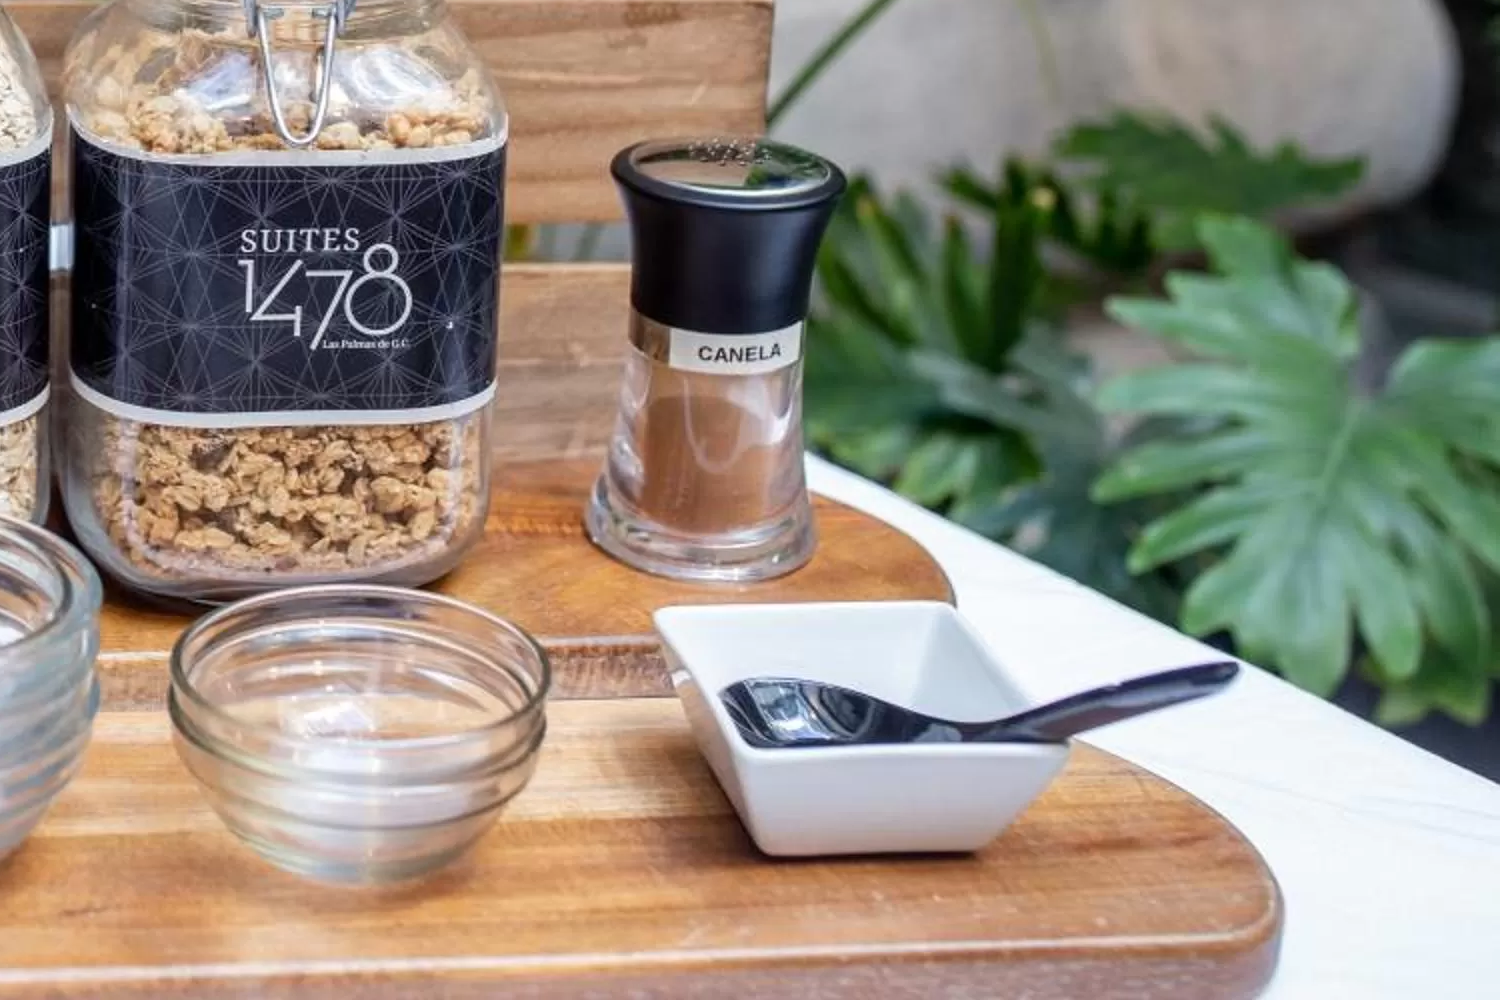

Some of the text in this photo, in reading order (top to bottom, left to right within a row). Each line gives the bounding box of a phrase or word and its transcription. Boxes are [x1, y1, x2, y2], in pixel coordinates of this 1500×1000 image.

[241, 227, 360, 253] SUITES
[237, 242, 413, 350] 1478
[323, 339, 339, 349] Las
[341, 339, 377, 349] Palmas
[378, 339, 390, 349] de
[698, 342, 782, 363] CANELA
